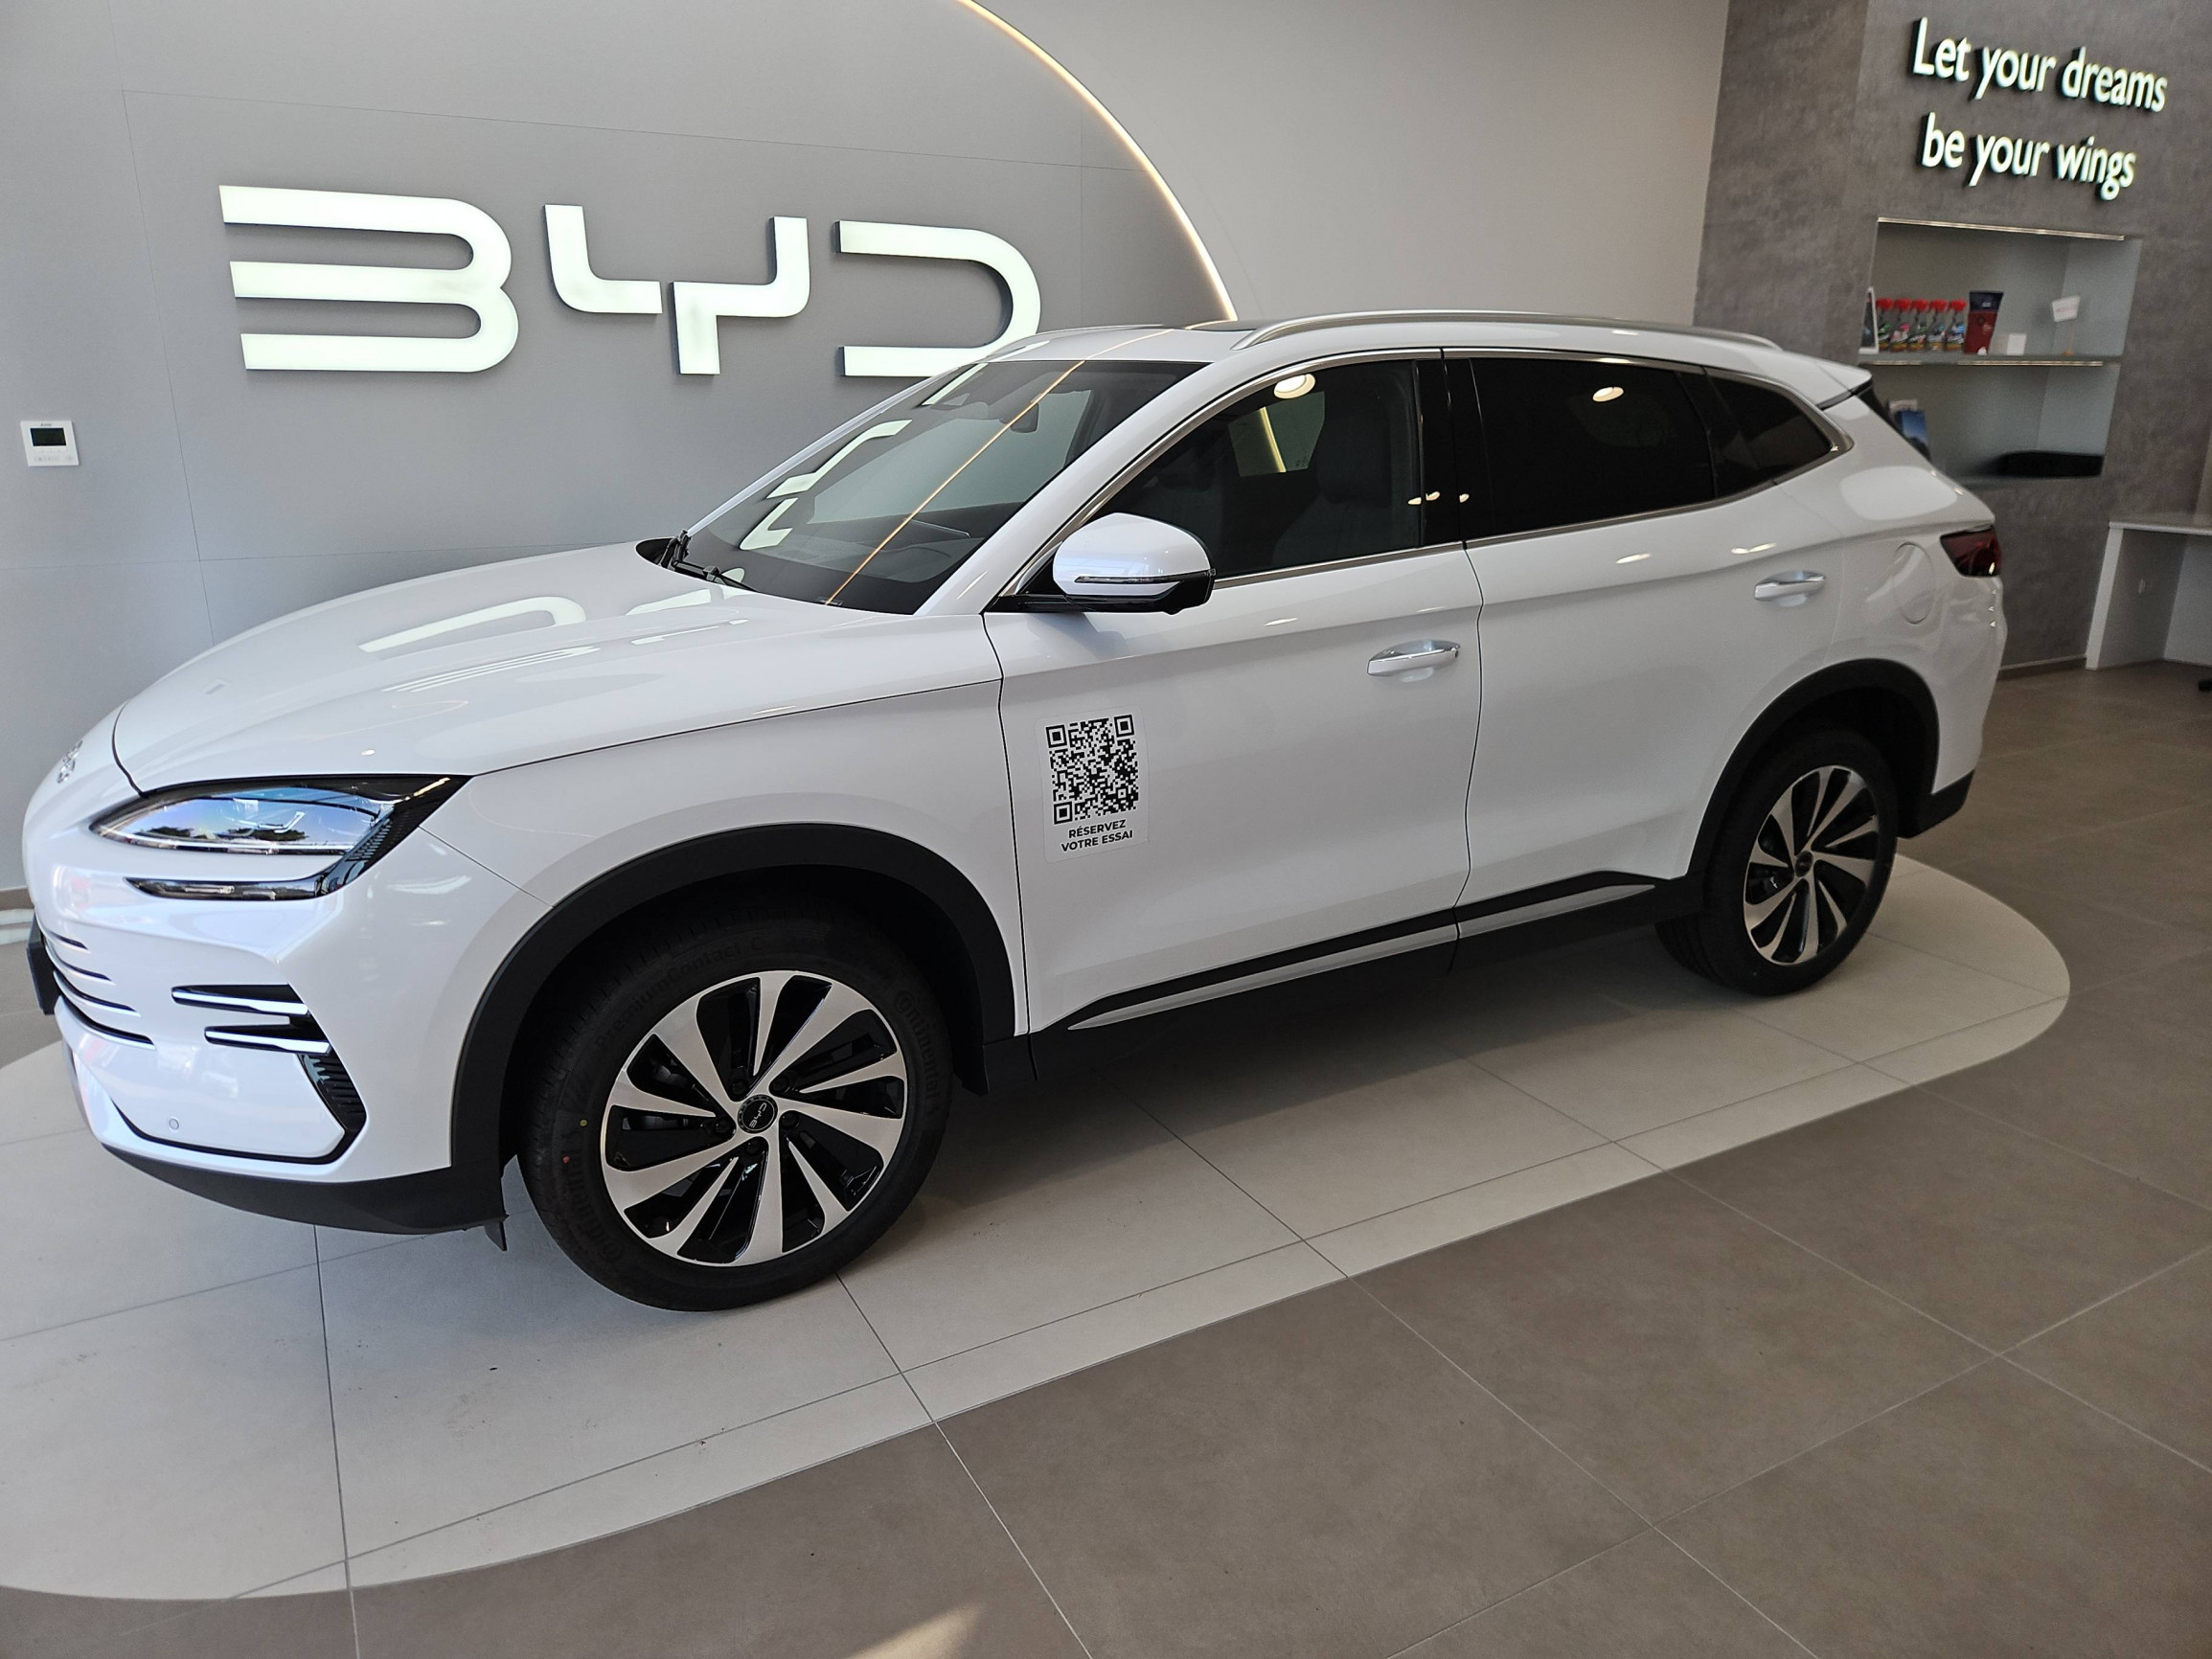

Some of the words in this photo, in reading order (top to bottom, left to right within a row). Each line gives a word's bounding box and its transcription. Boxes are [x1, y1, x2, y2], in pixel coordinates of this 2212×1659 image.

[1912, 16, 1971, 82] Let
[1973, 46, 2057, 101] your
[2061, 46, 2168, 112] dreams
[1921, 111, 1965, 169] be
[1968, 133, 2049, 187] your
[2056, 135, 2136, 201] wings
[218, 184, 1042, 378] BYD
[1060, 836, 1099, 852] VOTRE
[1102, 830, 1133, 845] ESSAI
[1068, 819, 1127, 839] RÉSERVEZ
[748, 1102, 767, 1128] BYD
